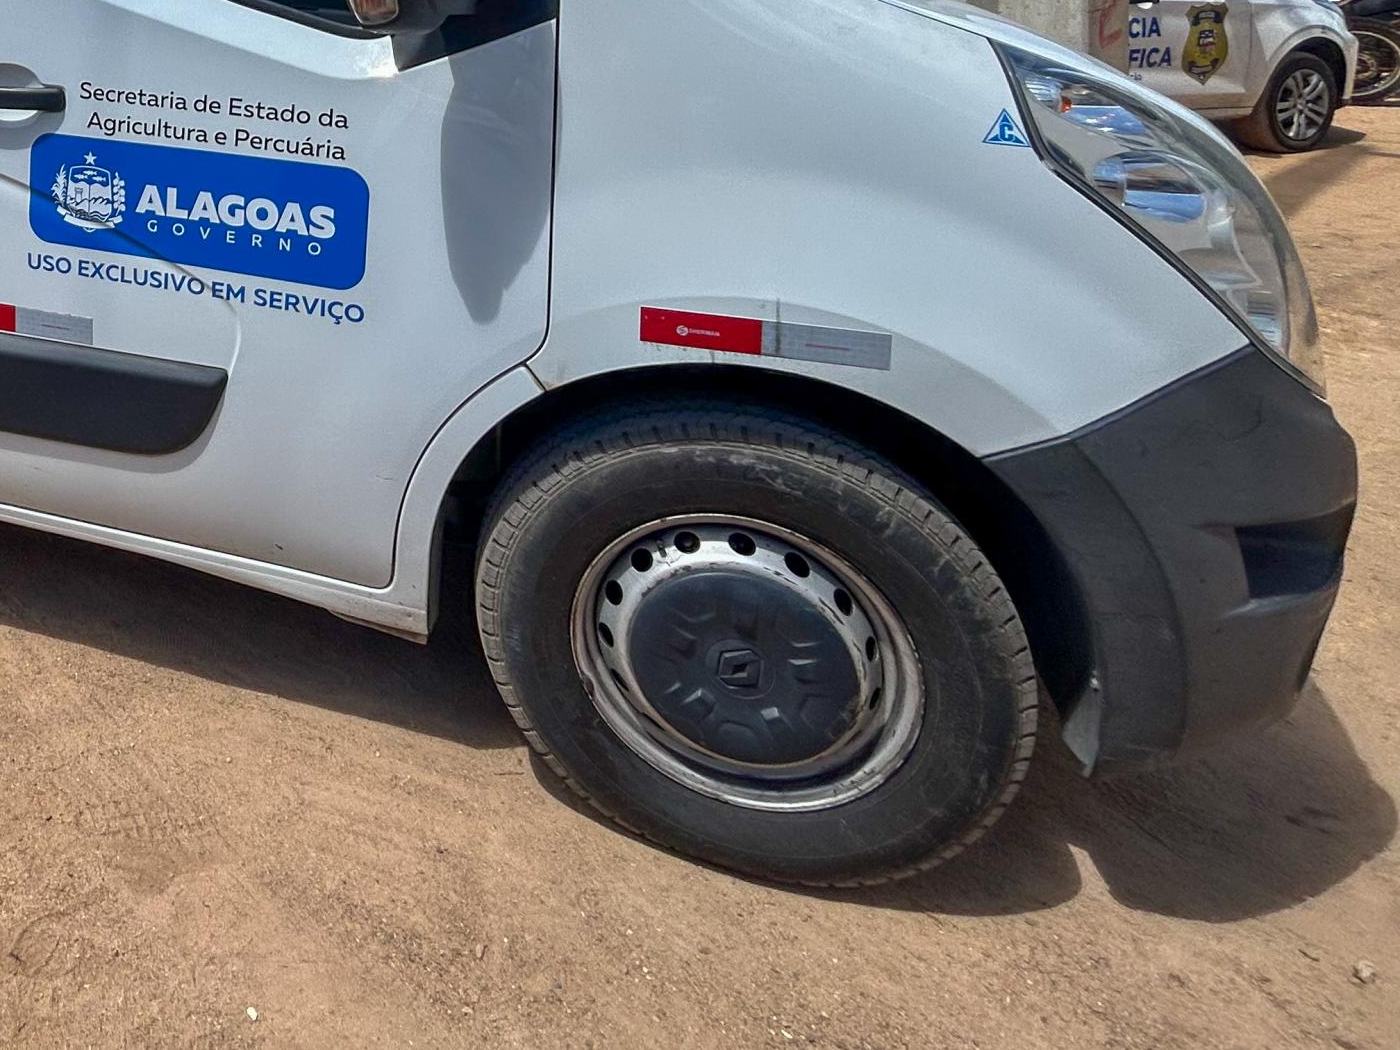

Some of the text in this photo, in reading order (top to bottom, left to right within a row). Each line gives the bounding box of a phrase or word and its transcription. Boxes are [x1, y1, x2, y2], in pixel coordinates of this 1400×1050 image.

[1128, 17, 1161, 39] CIA
[1128, 47, 1172, 68] FICA
[80, 81, 349, 129] Secretaria de Estado da
[87, 112, 346, 161] Agricultura e Percuária
[135, 184, 336, 239] ALAGOAS
[148, 219, 321, 256] GOVERNO
[27, 252, 365, 325] USO EXCLUSIVO EM SERVIÇO
